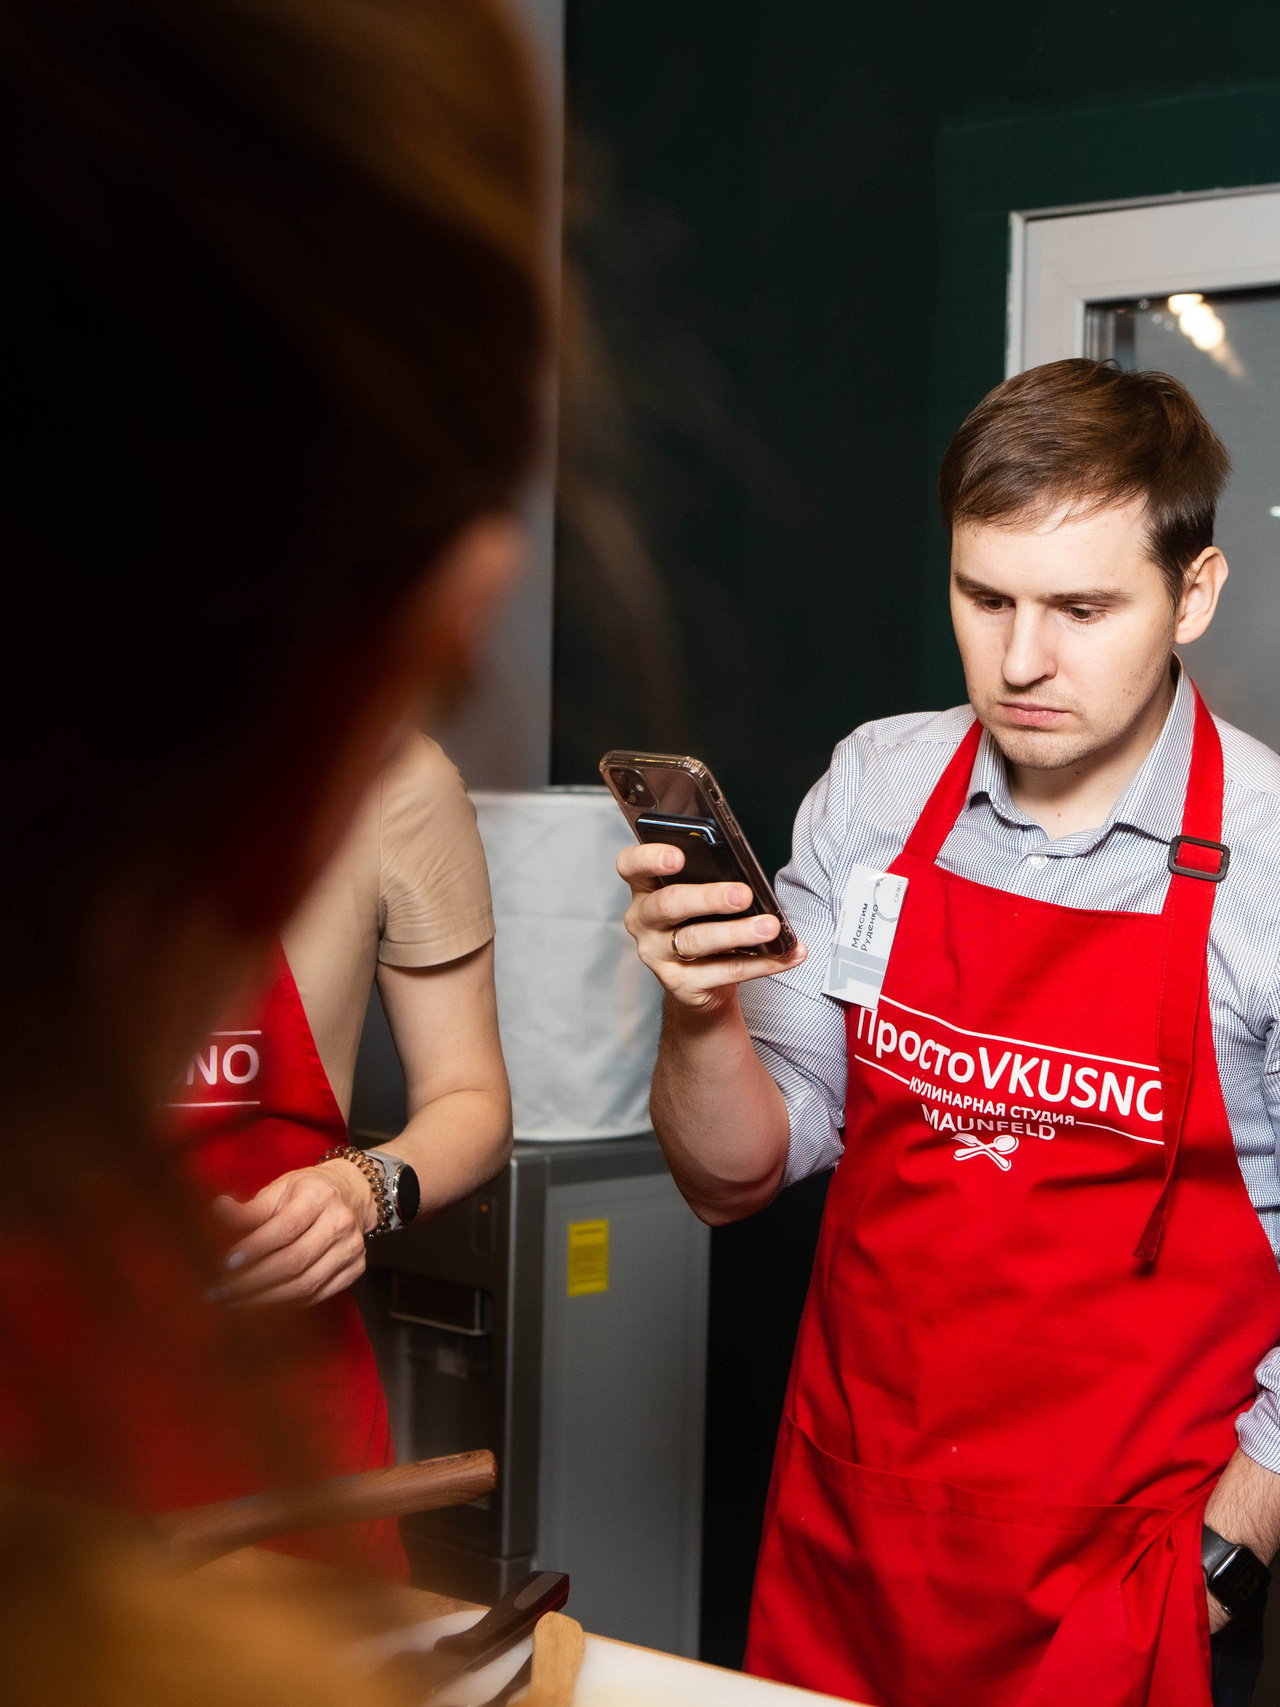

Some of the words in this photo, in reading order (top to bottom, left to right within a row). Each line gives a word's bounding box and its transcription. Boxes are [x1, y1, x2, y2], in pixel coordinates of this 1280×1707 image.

[851, 903, 869, 949] Максим
[860, 903, 879, 952] Руденко
[909, 1076, 1006, 1117] КУЛИНАРНАЯ
[1010, 1105, 1076, 1127] СТУДИЯ
[921, 1103, 1057, 1141] MAUNFELD
